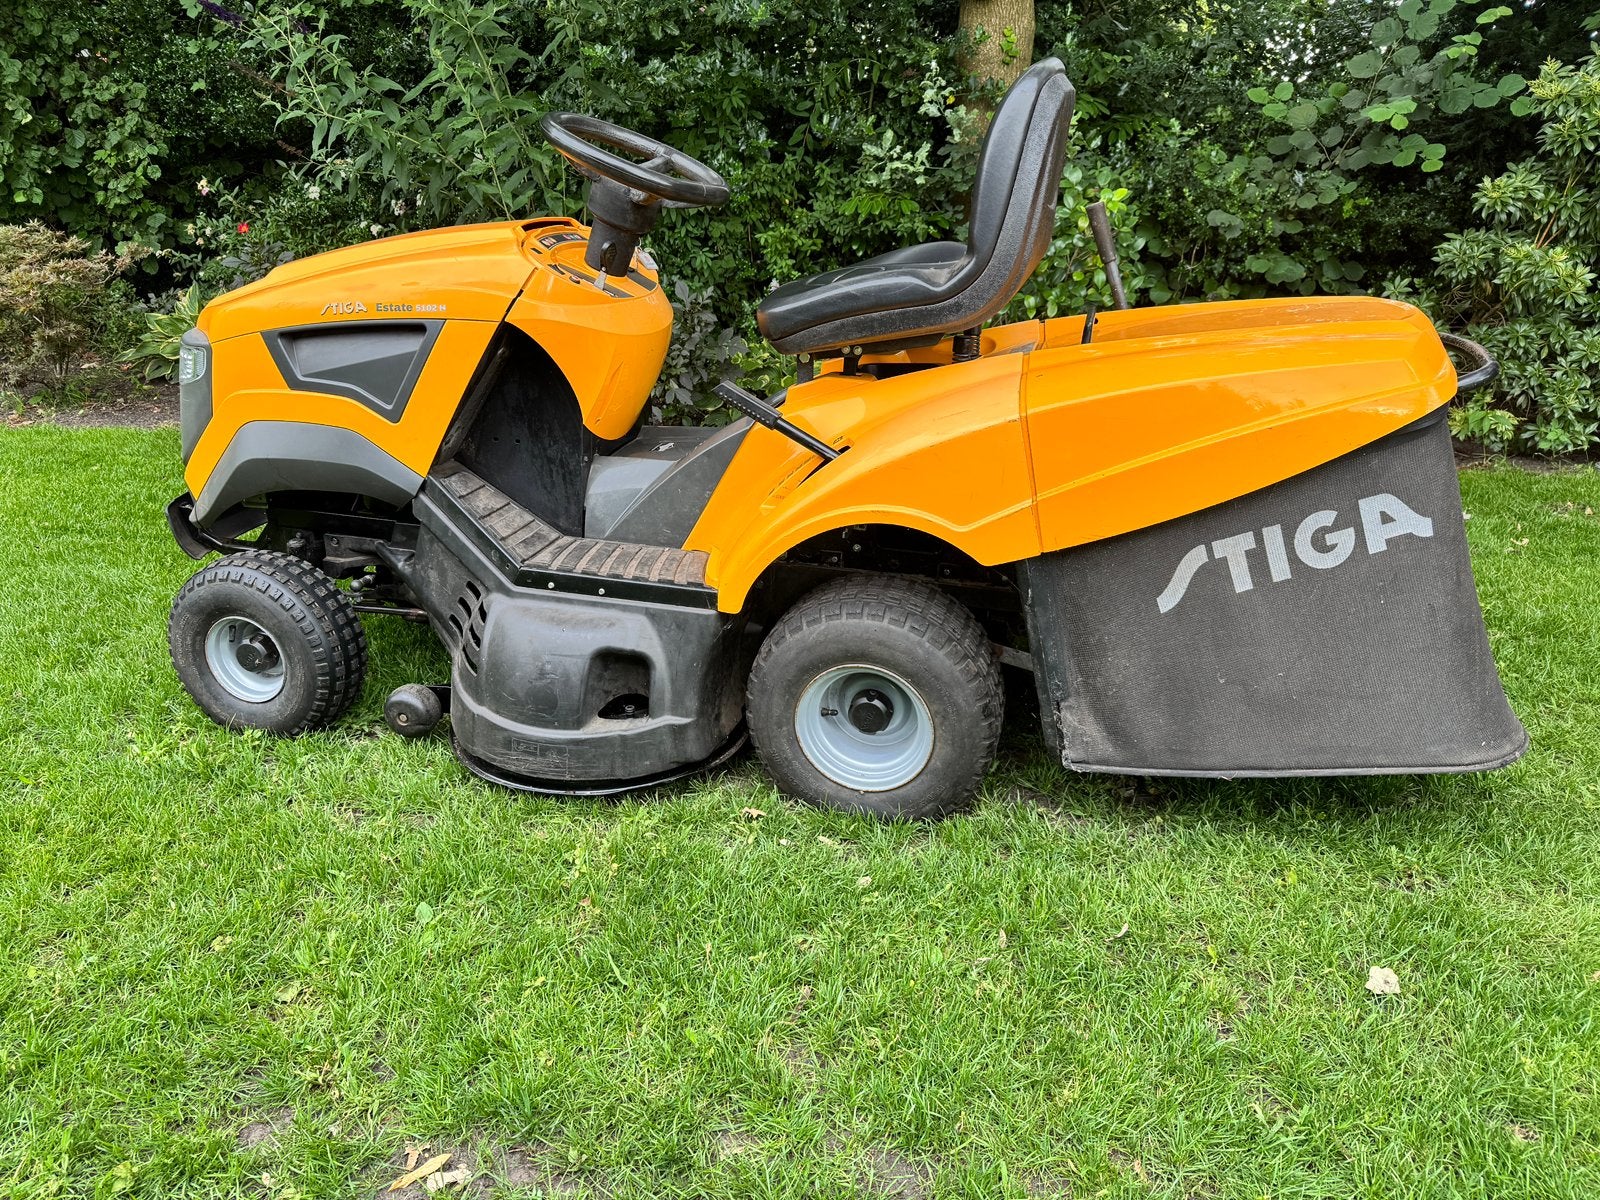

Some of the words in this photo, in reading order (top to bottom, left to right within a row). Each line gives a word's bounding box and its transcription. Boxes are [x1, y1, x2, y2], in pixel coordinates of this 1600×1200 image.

[320, 301, 368, 315] STIGA
[376, 302, 413, 312] Estate
[416, 304, 437, 312] 5102
[1157, 494, 1433, 613] STIGA
